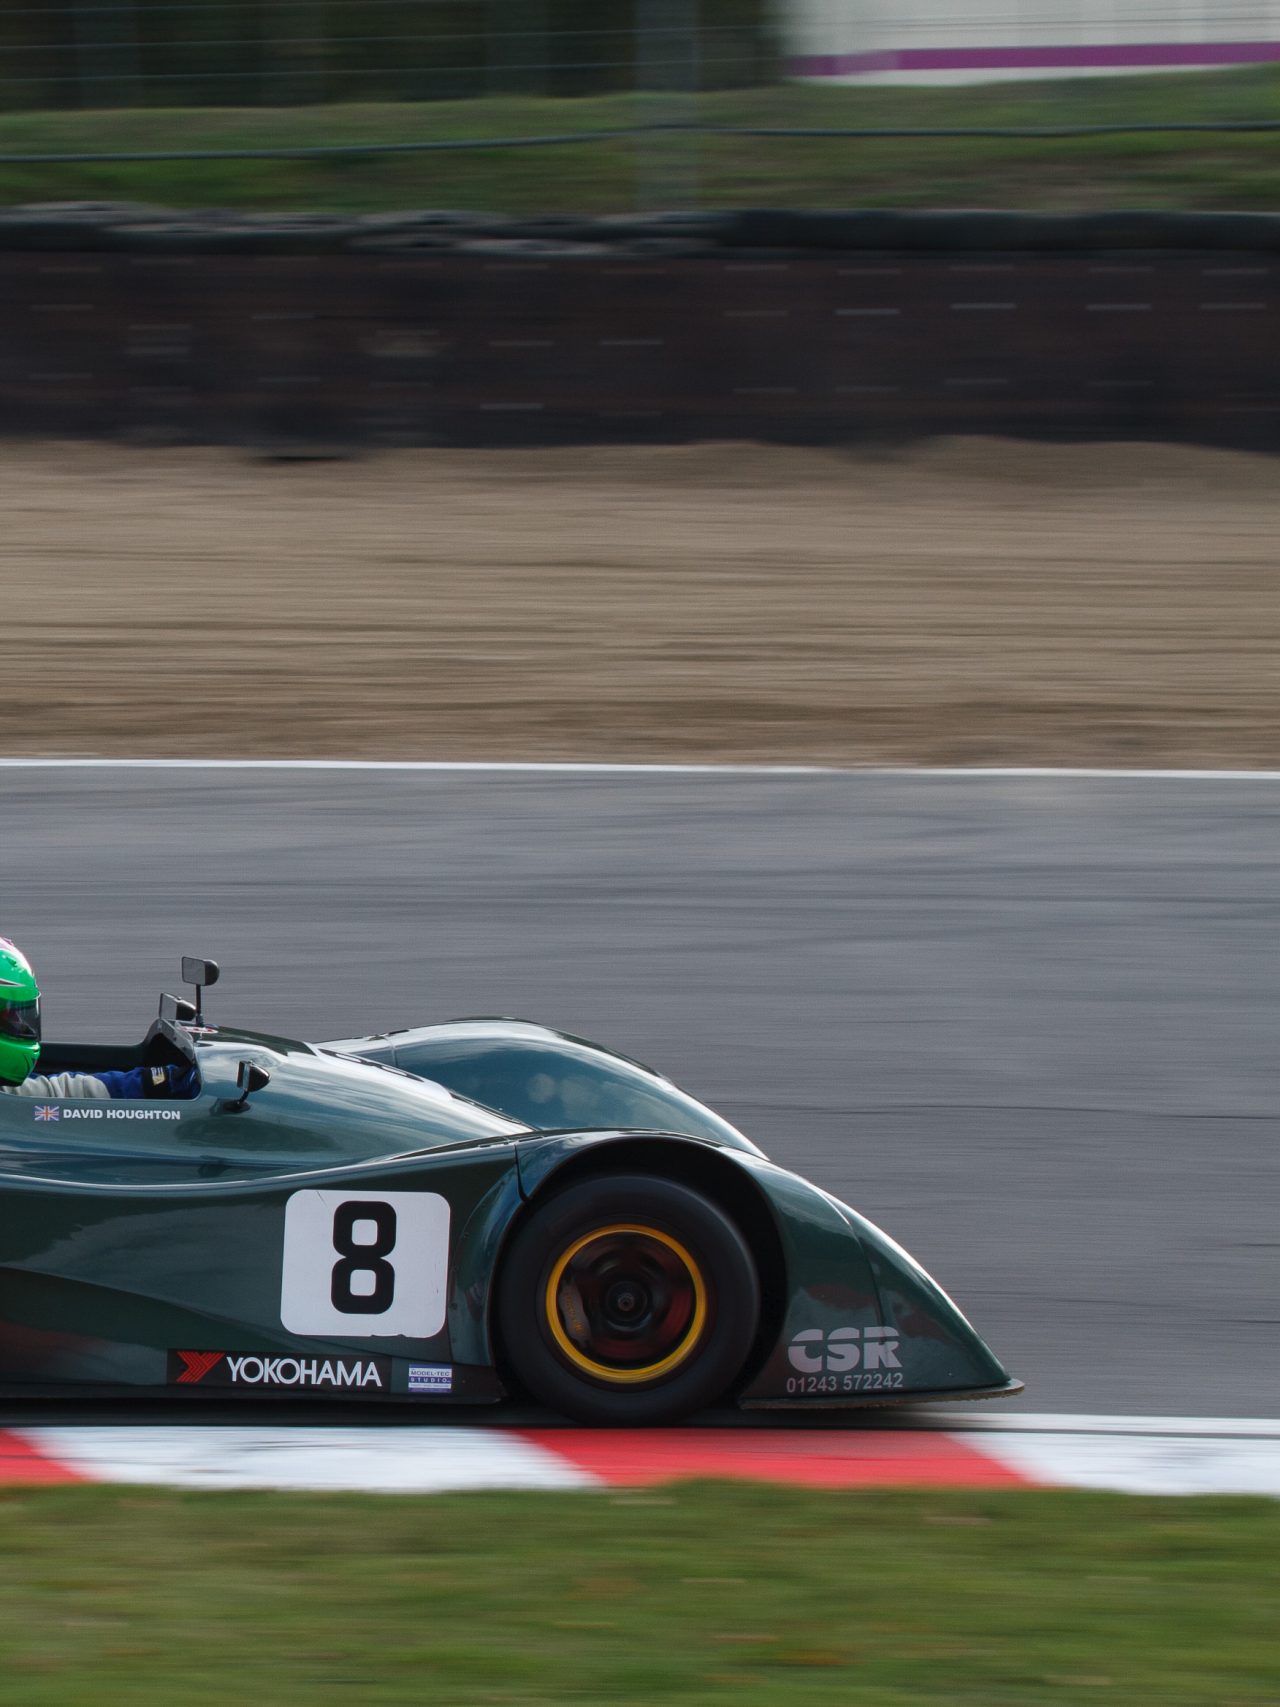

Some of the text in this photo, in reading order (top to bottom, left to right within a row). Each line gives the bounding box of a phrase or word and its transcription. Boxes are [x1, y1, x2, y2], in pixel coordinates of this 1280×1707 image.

[63, 1109, 181, 1120] DAVID HOUGHTON
[330, 1200, 397, 1315] 8
[787, 1326, 904, 1374] CSR
[226, 1355, 383, 1387] YOKOHAMA
[786, 1372, 904, 1393] 01243 572242
